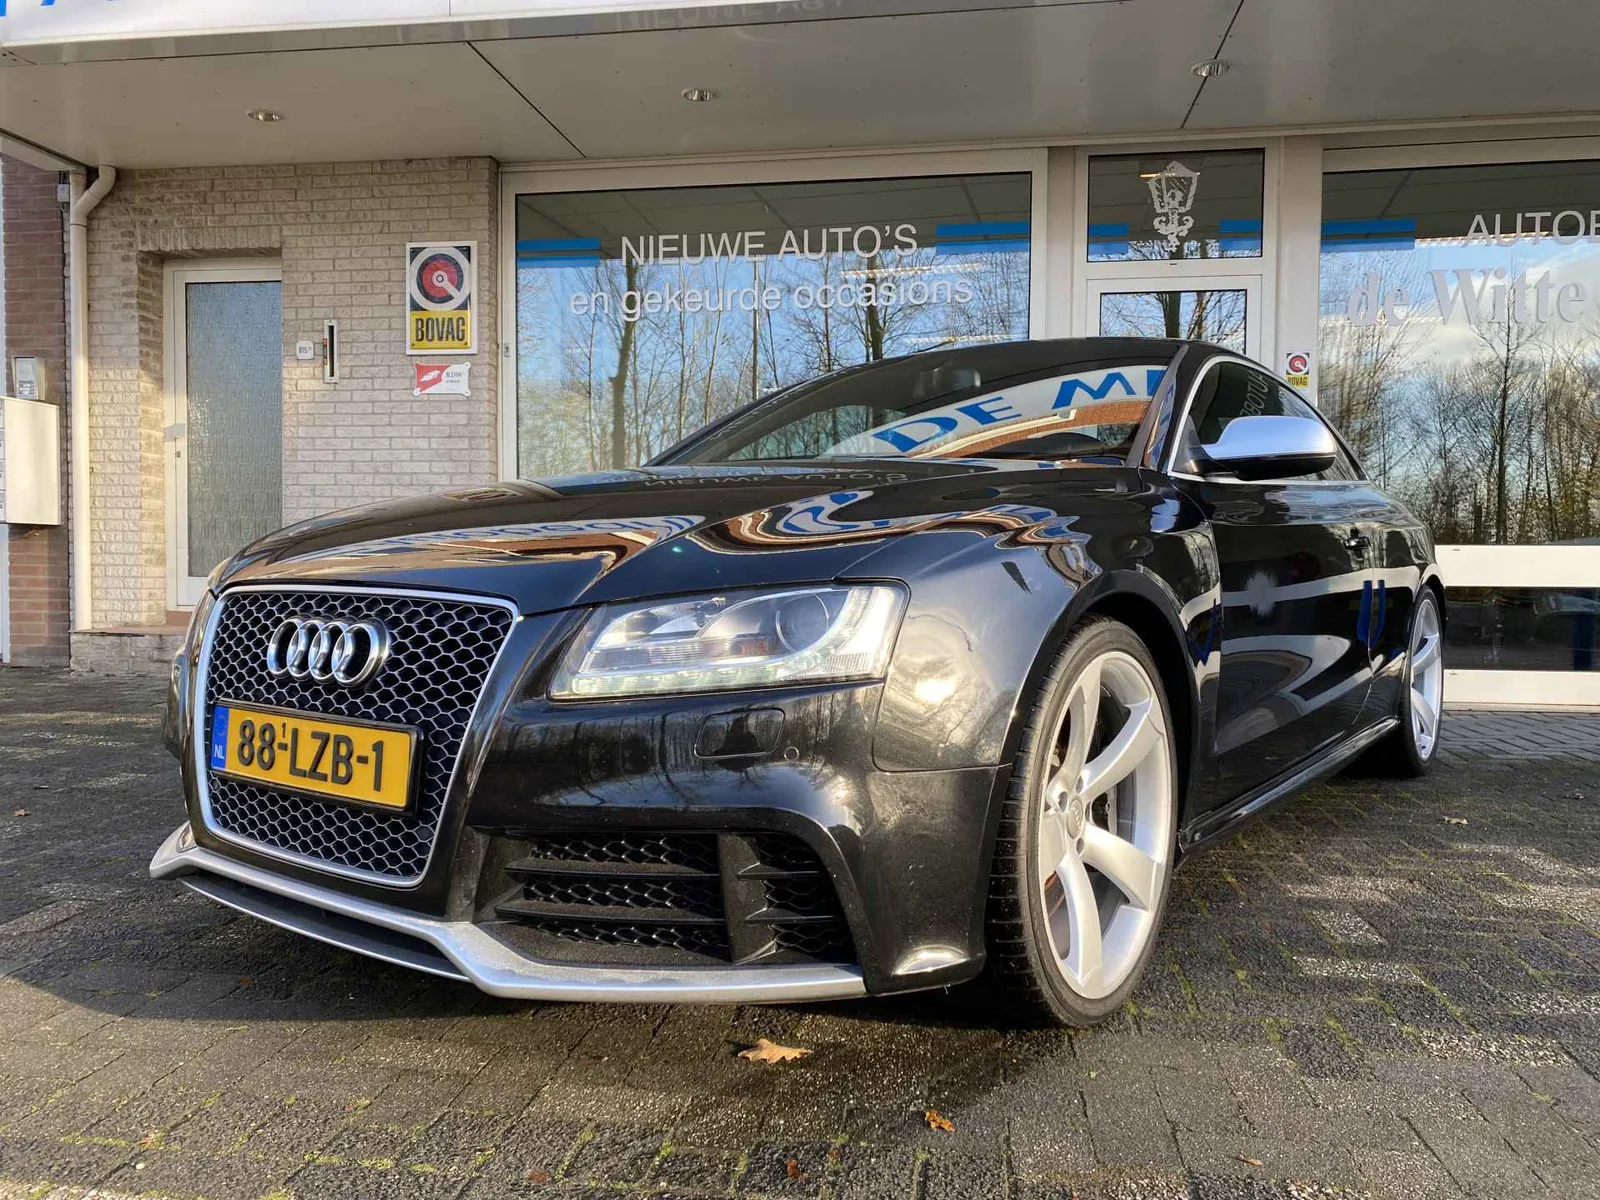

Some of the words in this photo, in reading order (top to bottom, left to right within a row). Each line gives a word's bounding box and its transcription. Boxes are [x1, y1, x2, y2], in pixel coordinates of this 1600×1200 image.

[620, 230, 766, 266] NIEUWE
[777, 223, 919, 261] AUTO'S
[569, 289, 609, 315] en
[621, 280, 782, 322] gekeurde
[793, 275, 974, 310] occasions
[1349, 271, 1411, 327] de
[1427, 267, 1588, 325] Witte
[414, 316, 466, 342] BOVAG
[214, 744, 225, 760] NL
[236, 718, 385, 793] 88-LZB-1
